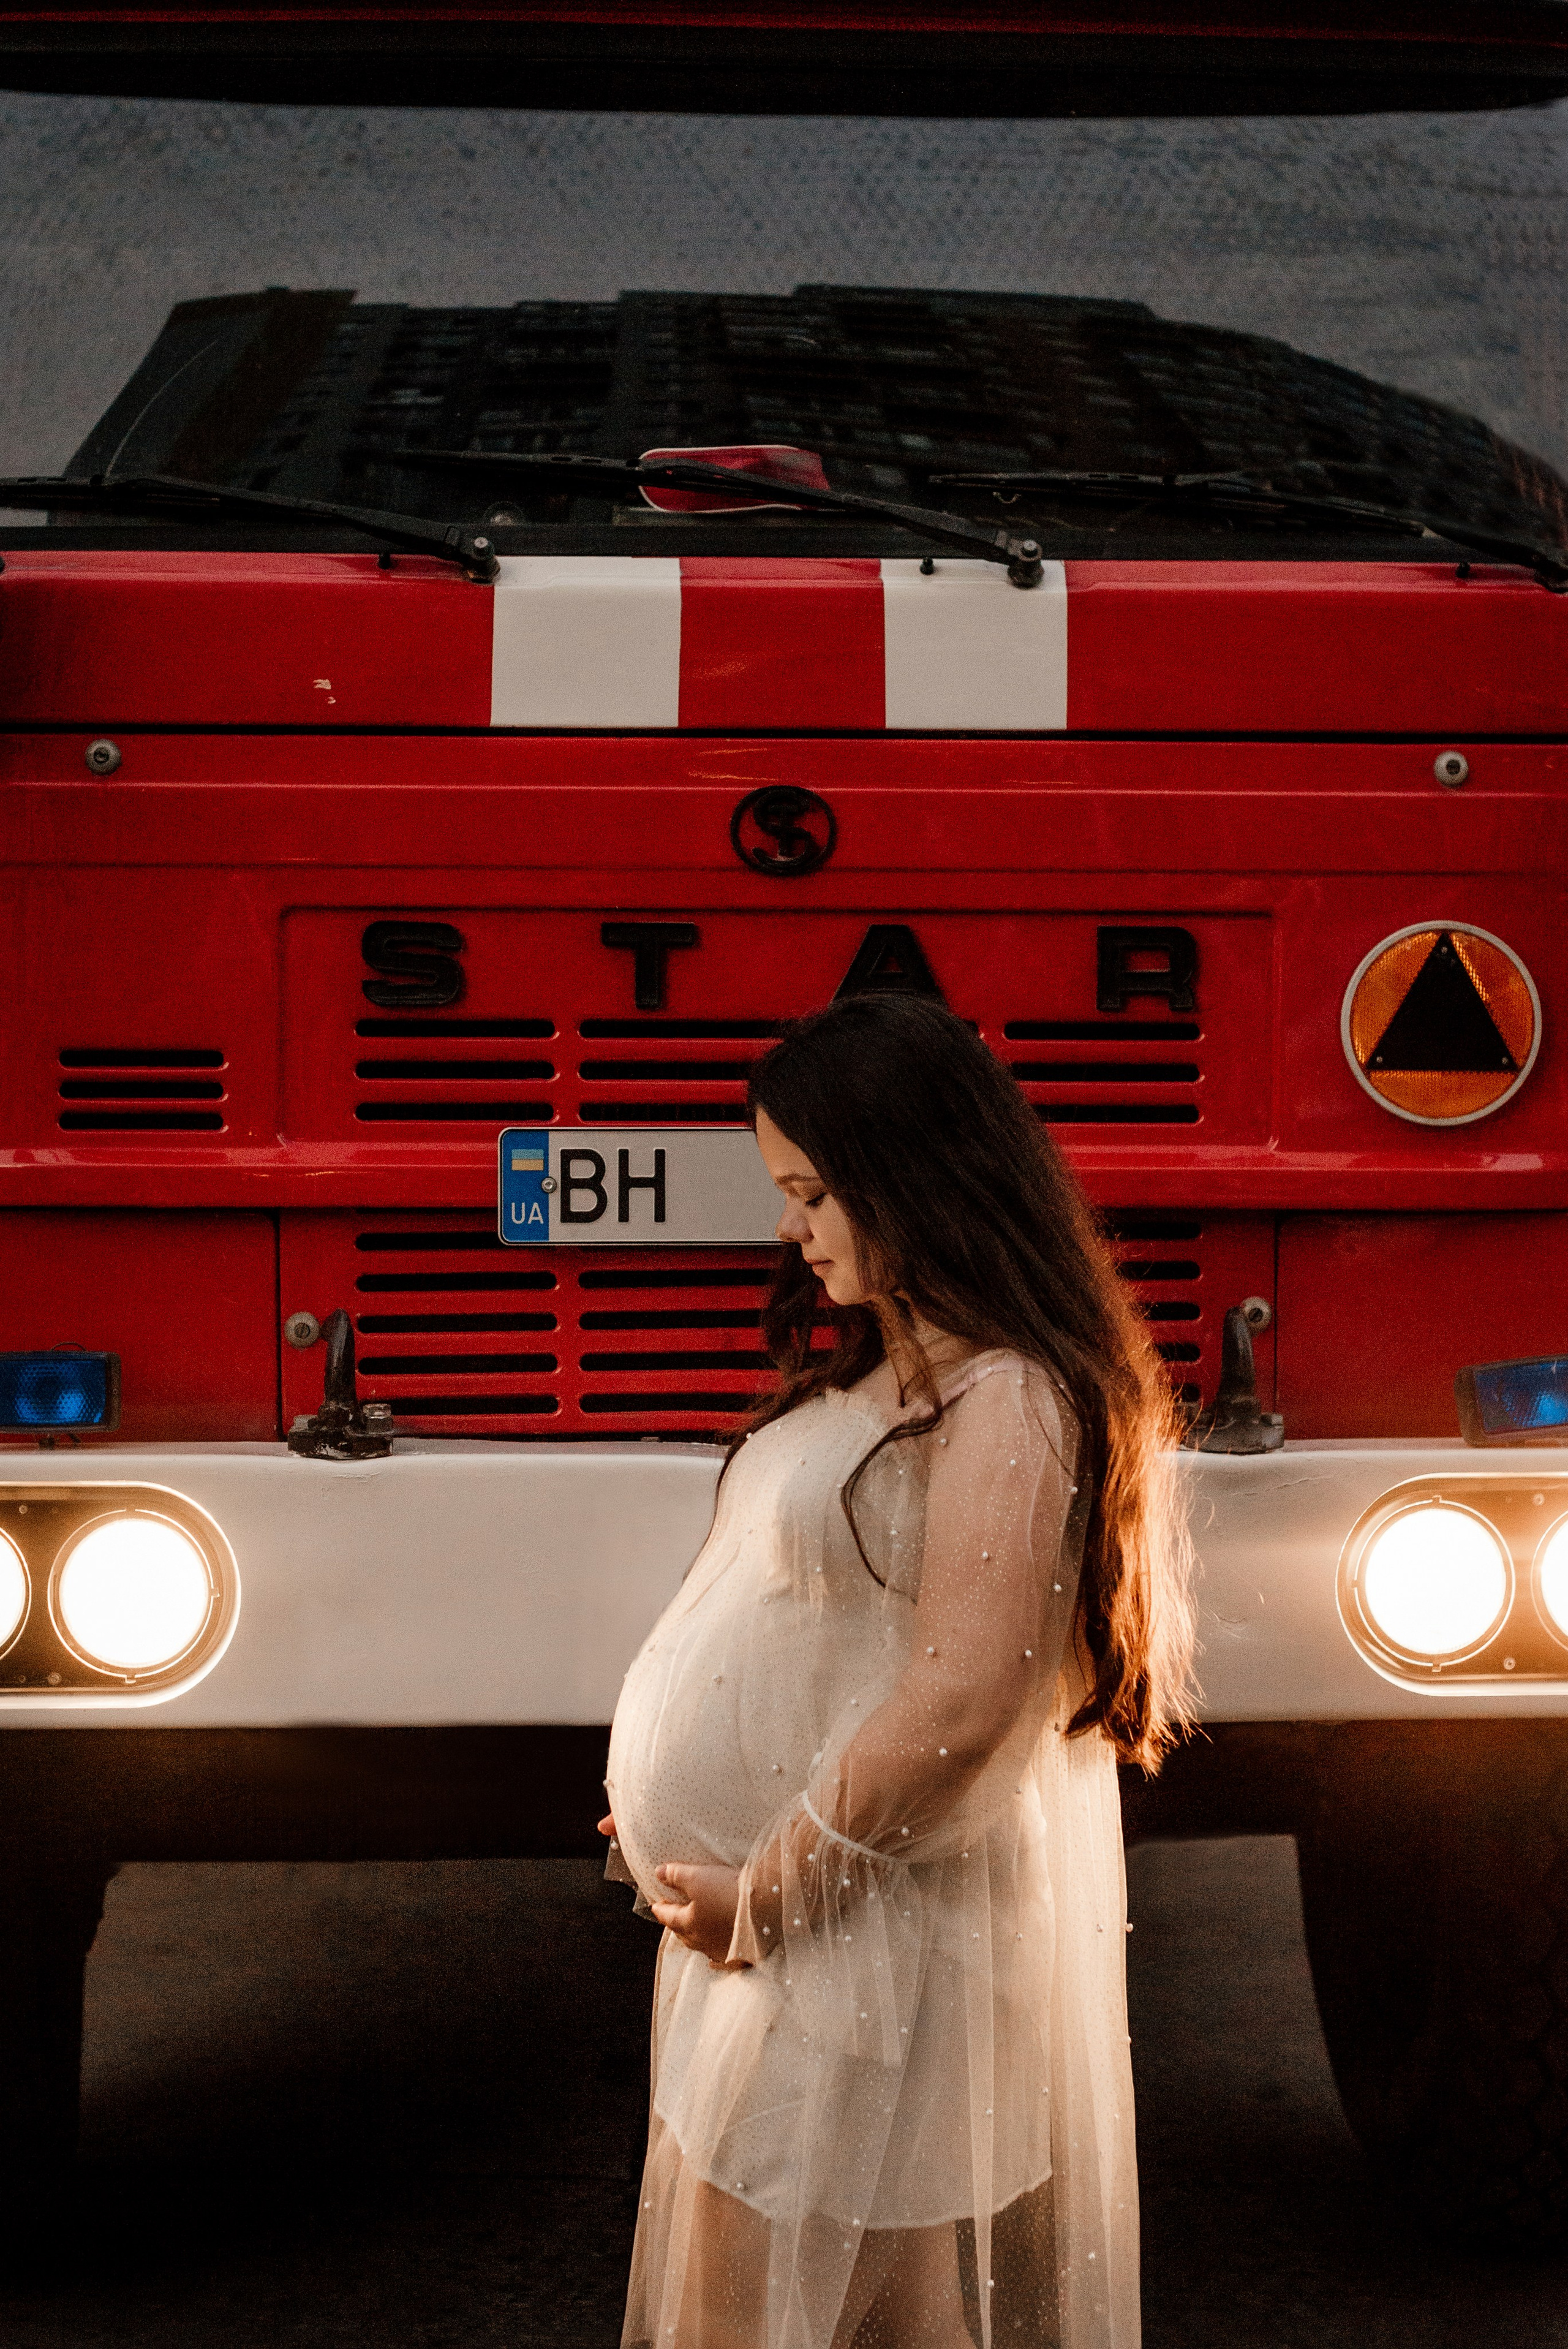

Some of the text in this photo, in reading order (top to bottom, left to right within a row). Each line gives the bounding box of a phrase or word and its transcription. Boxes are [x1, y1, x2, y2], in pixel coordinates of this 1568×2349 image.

[361, 920, 1199, 1012] STAR
[511, 1201, 545, 1225] UA
[559, 1148, 667, 1224] BH
